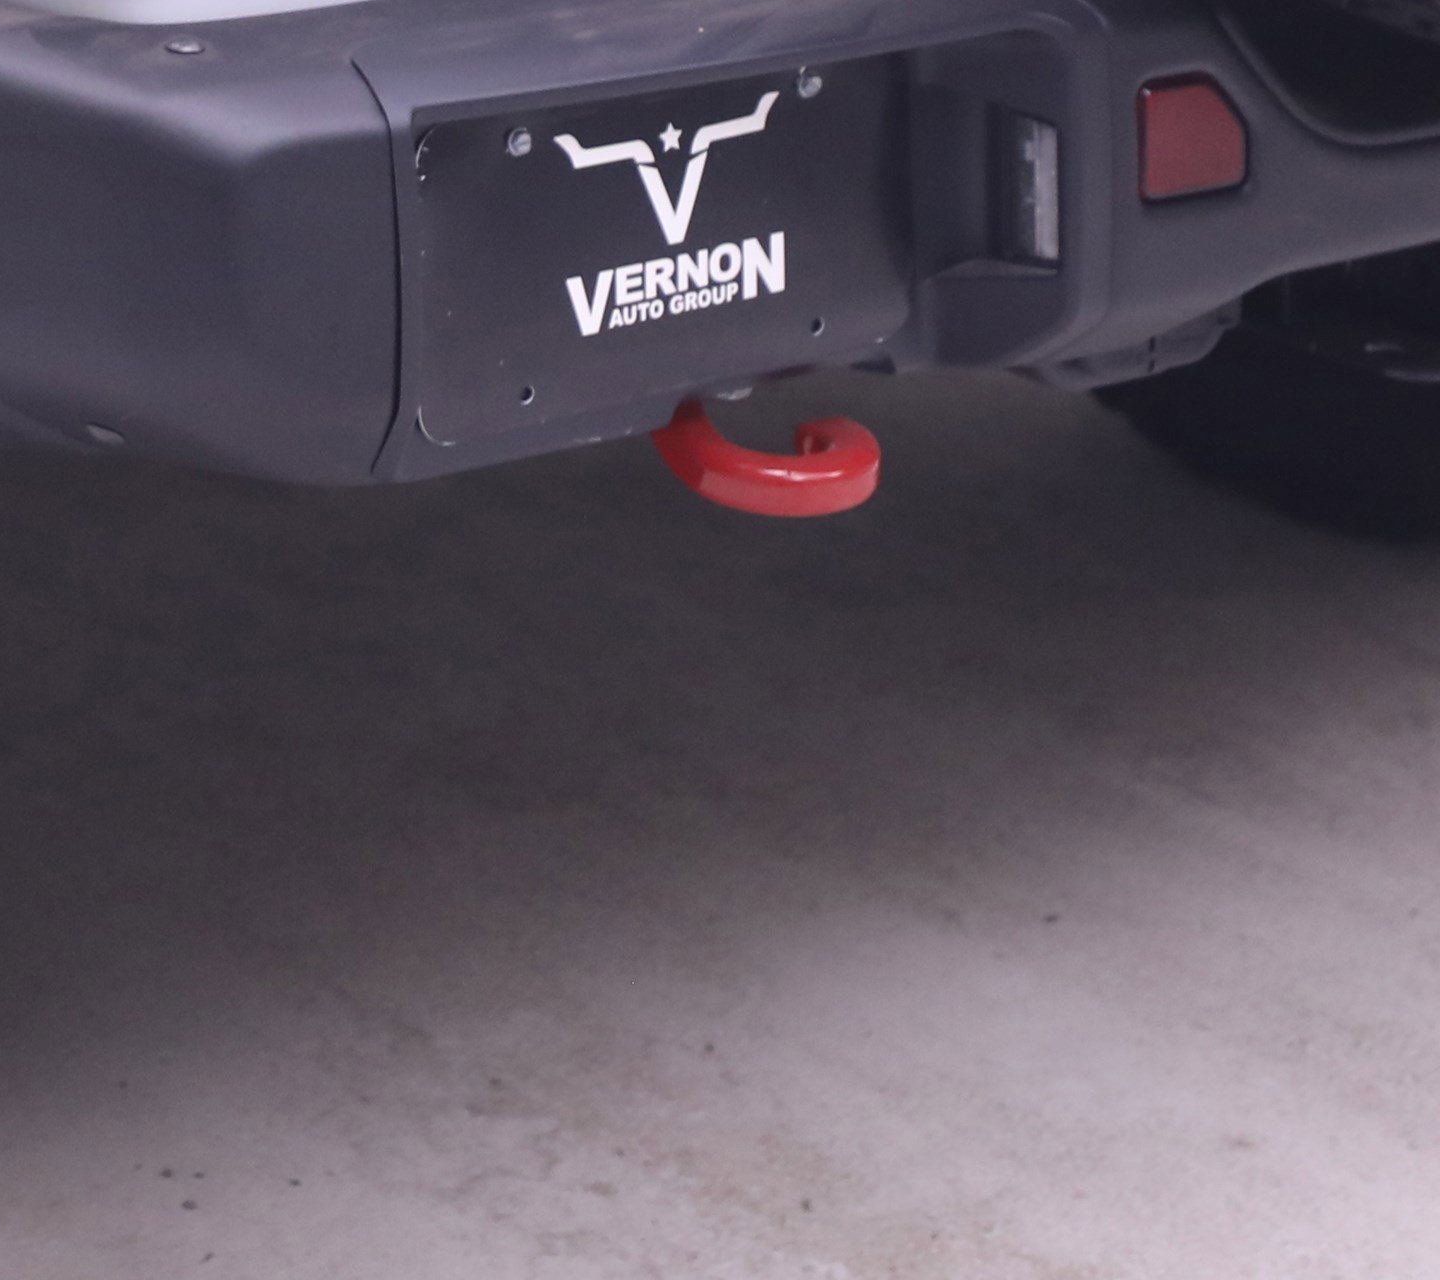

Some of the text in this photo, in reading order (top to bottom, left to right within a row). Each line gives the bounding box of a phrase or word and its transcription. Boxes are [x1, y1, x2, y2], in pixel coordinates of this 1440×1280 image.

[565, 230, 787, 337] VERNON
[608, 280, 740, 330] AUTO GROUP
